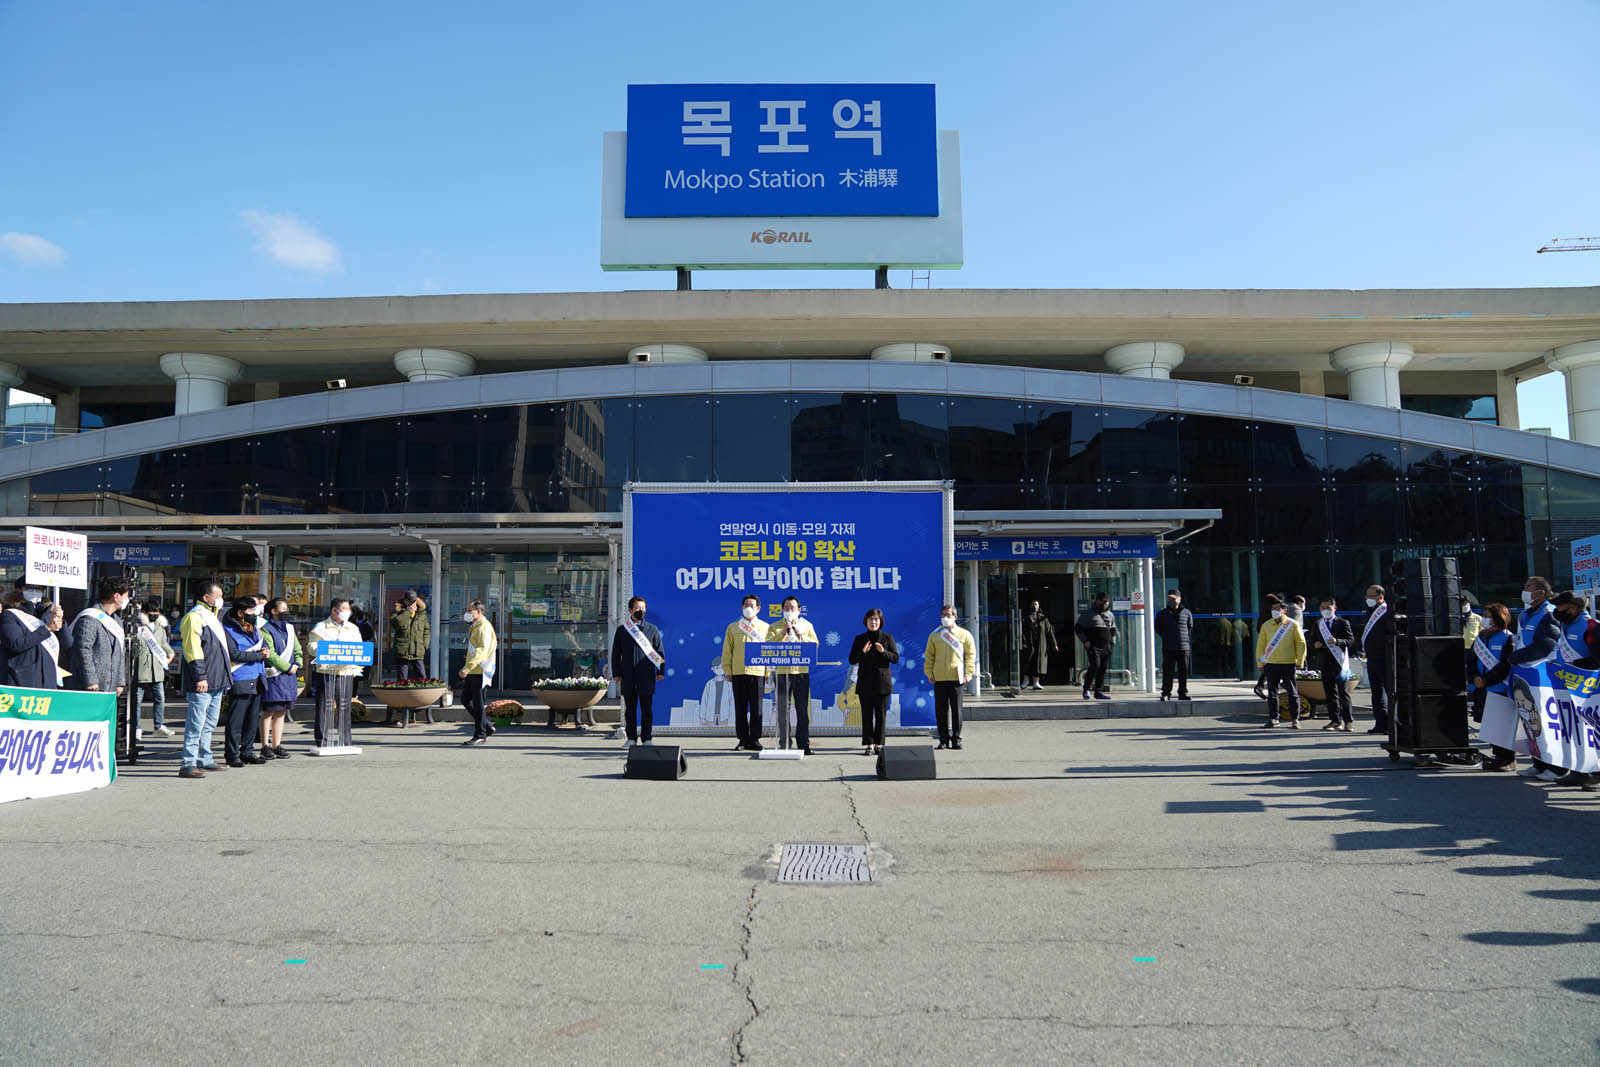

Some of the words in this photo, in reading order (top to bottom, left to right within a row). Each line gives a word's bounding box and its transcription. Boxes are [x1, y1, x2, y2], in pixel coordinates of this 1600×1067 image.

[664, 169, 743, 193] Mokpo
[748, 168, 825, 189] Station
[838, 168, 899, 188] 木浦驛
[750, 229, 813, 244] KORAIL
[719, 522, 769, 536] 연말연시
[830, 522, 856, 536] 자제
[33, 533, 65, 547] 코로나19
[47, 549, 69, 562] 여기서
[719, 540, 782, 562] 코로나
[787, 541, 807, 561] 19
[813, 540, 856, 562] 확산
[33, 561, 57, 574] 막아야
[675, 566, 745, 591] 여기서
[752, 566, 824, 590] 막아야
[830, 566, 901, 591] 합니다
[18, 695, 52, 716] 자제
